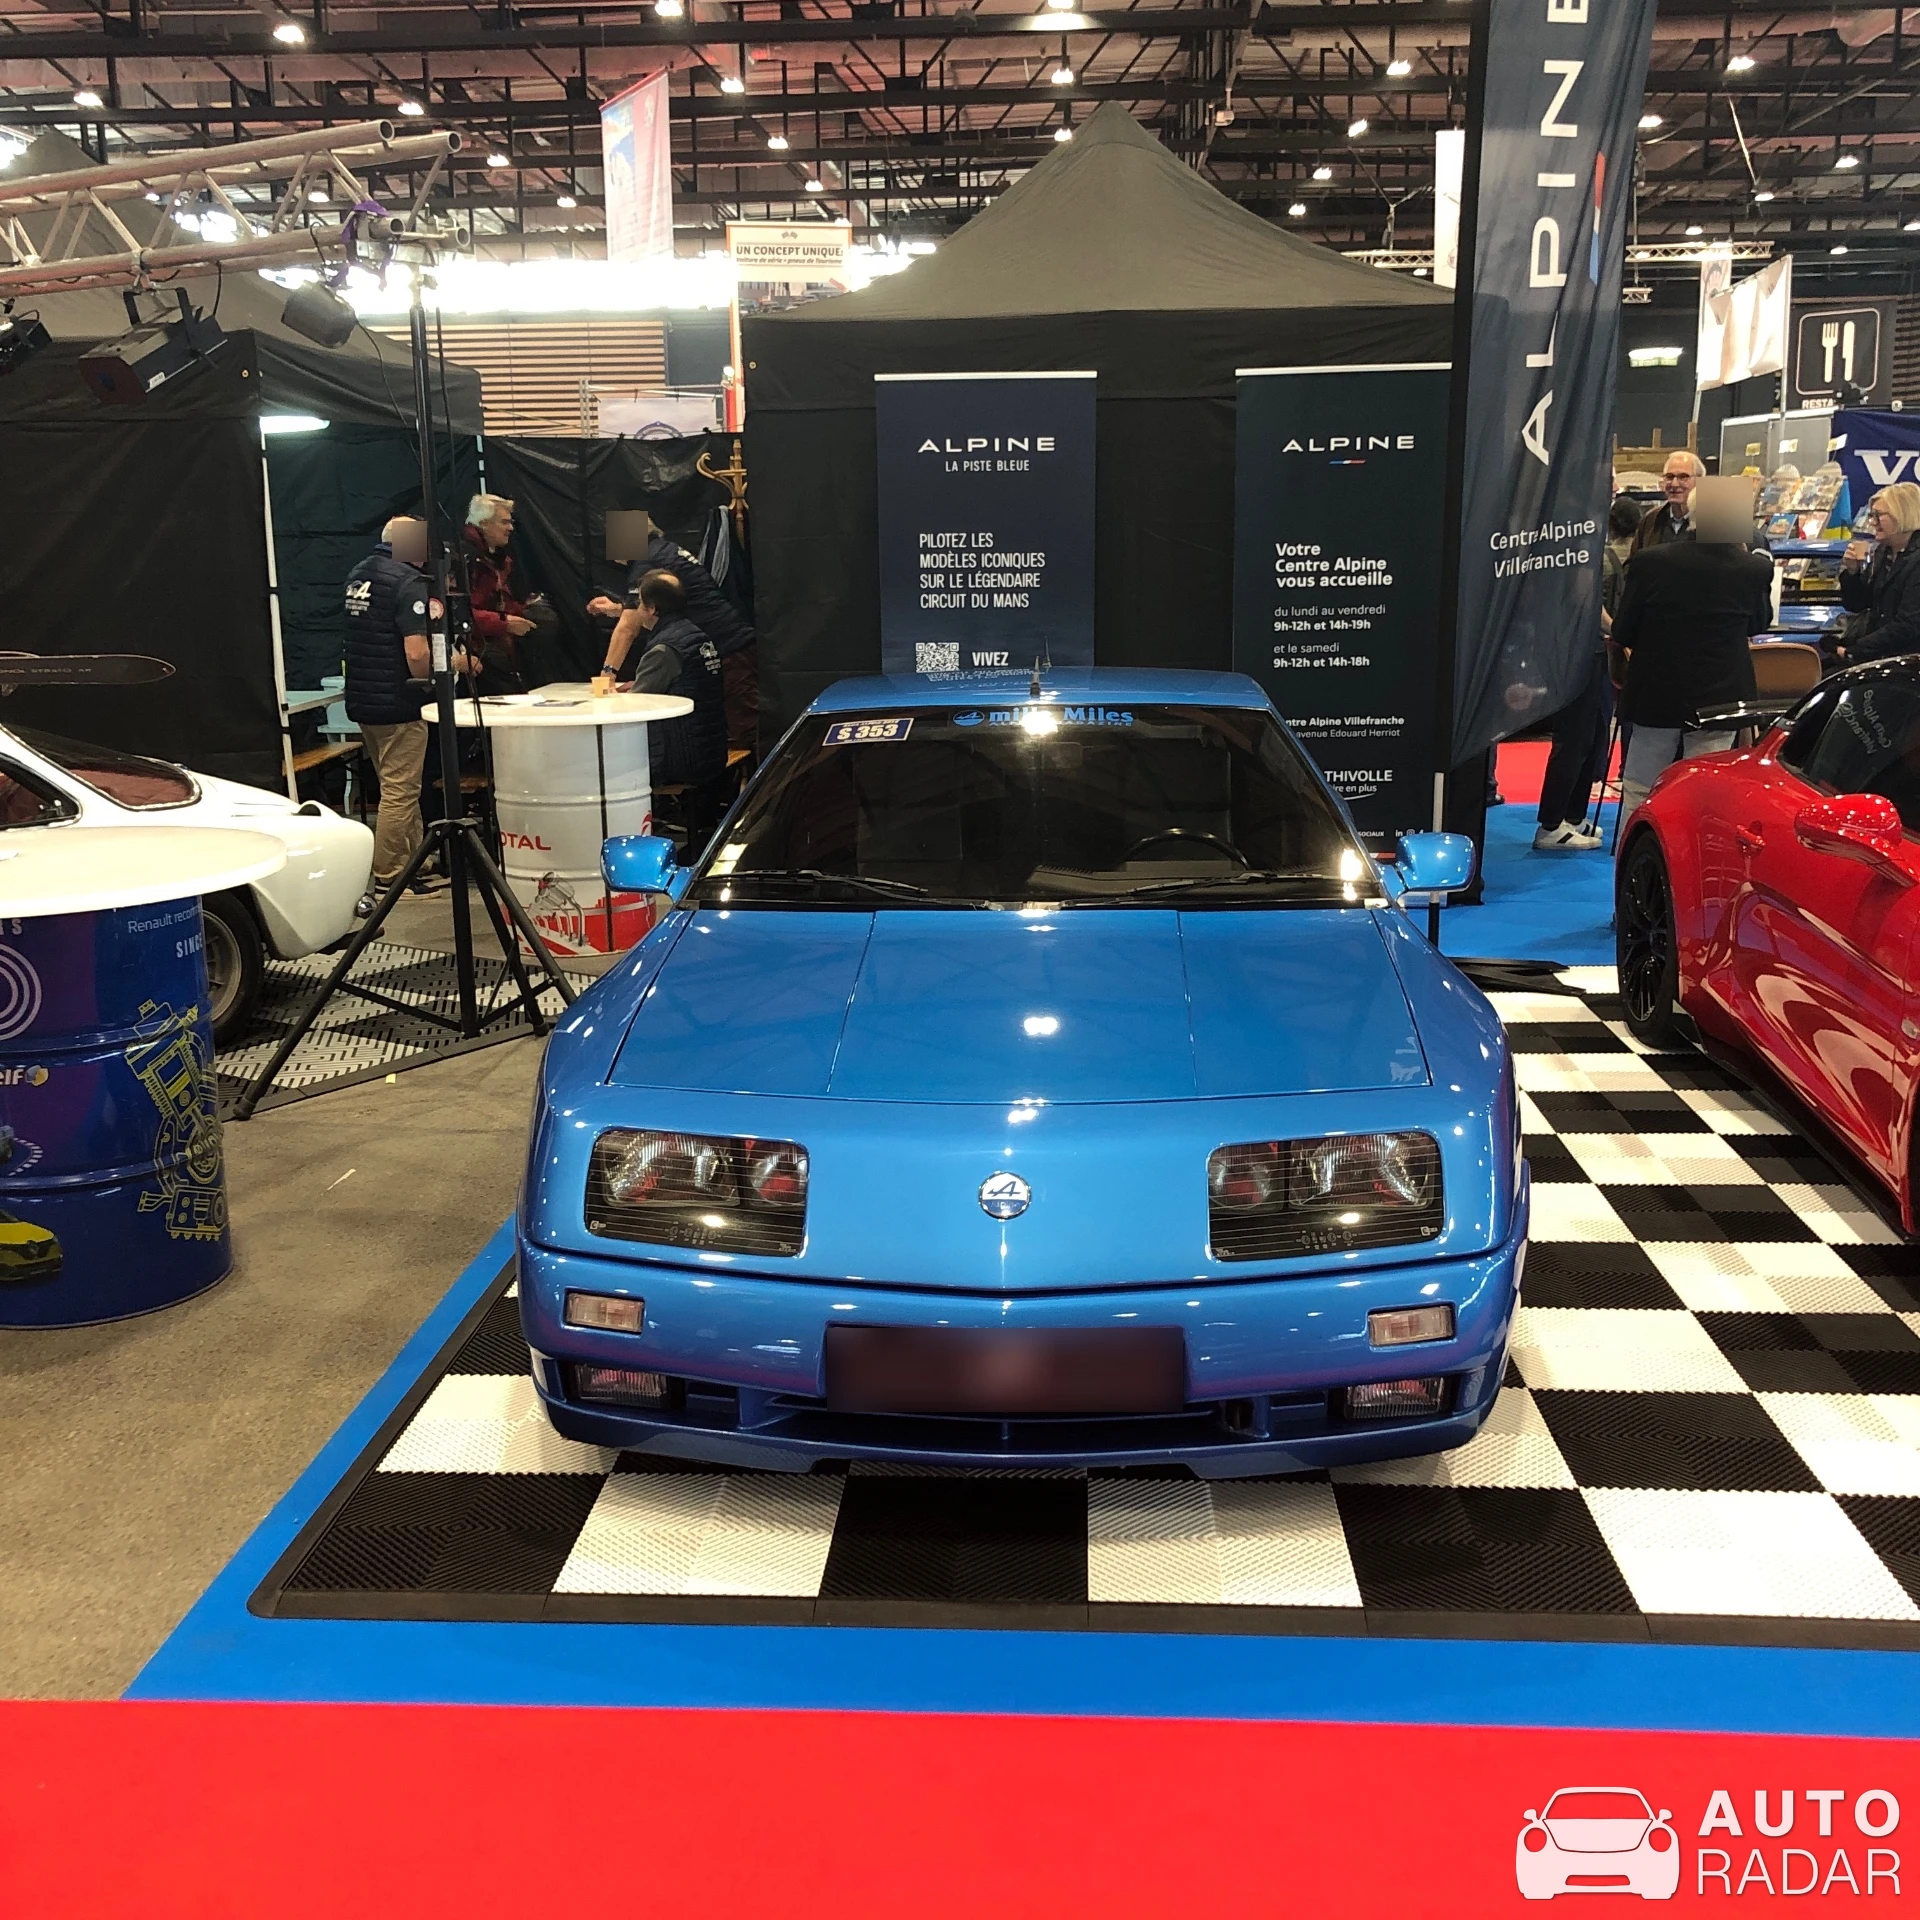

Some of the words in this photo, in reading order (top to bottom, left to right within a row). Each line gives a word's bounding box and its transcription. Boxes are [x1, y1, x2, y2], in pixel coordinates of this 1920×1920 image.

[736, 246, 751, 255] UN
[753, 246, 800, 256] CONCEPT
[1802, 399, 1834, 409] RESTA
[918, 437, 1055, 453] ALPINE
[1282, 435, 1415, 452] ALPINE
[945, 460, 959, 472] LA
[963, 460, 992, 472] PISTE
[997, 459, 1030, 472] BLEUE
[1539, 520, 1596, 543] Alpine
[919, 533, 967, 548] PILOTEZ
[971, 533, 993, 548] LES
[1275, 543, 1320, 556] Votre
[920, 551, 977, 568] MODÈLES
[981, 553, 1045, 569] ICONIQUES
[1275, 559, 1329, 572] Centre
[1334, 557, 1387, 573] Alpine
[920, 574, 944, 588] SUR
[949, 574, 963, 588] LE
[968, 571, 1041, 588] LÉGENDAIRE
[1276, 576, 1315, 587] vous
[1320, 571, 1393, 587] accueille
[920, 594, 966, 608] CIRCUIT
[971, 594, 988, 608] DU
[993, 593, 1029, 608] MANS
[1274, 606, 1288, 617] du
[1291, 606, 1318, 616] lundi
[1321, 607, 1334, 616] au
[1338, 604, 1386, 615] vendredi
[1274, 621, 1311, 631] 9h-12h
[1313, 622, 1326, 631] et
[1329, 619, 1371, 630] 14h-19h
[1273, 644, 1285, 654] et
[1287, 643, 1298, 653] le
[1300, 642, 1340, 653] samedi
[972, 652, 1009, 666] VIVEZ
[1273, 658, 1310, 668] 9h-12h
[1313, 659, 1325, 668] et
[1328, 656, 1370, 667] 14h-18h
[1063, 707, 1134, 722] Miles
[1285, 717, 1307, 726] ntre
[1309, 716, 1342, 727] Alpine
[1344, 715, 1405, 726] Villefranche
[837, 727, 852, 740] S
[855, 724, 898, 738] 353
[1330, 728, 1367, 738] Edouard
[1369, 728, 1401, 737] Herriot
[1324, 769, 1393, 782] THIVOLLE
[1358, 784, 1377, 793] plus
[500, 831, 551, 850] OTAL
[128, 913, 173, 933] Renault
